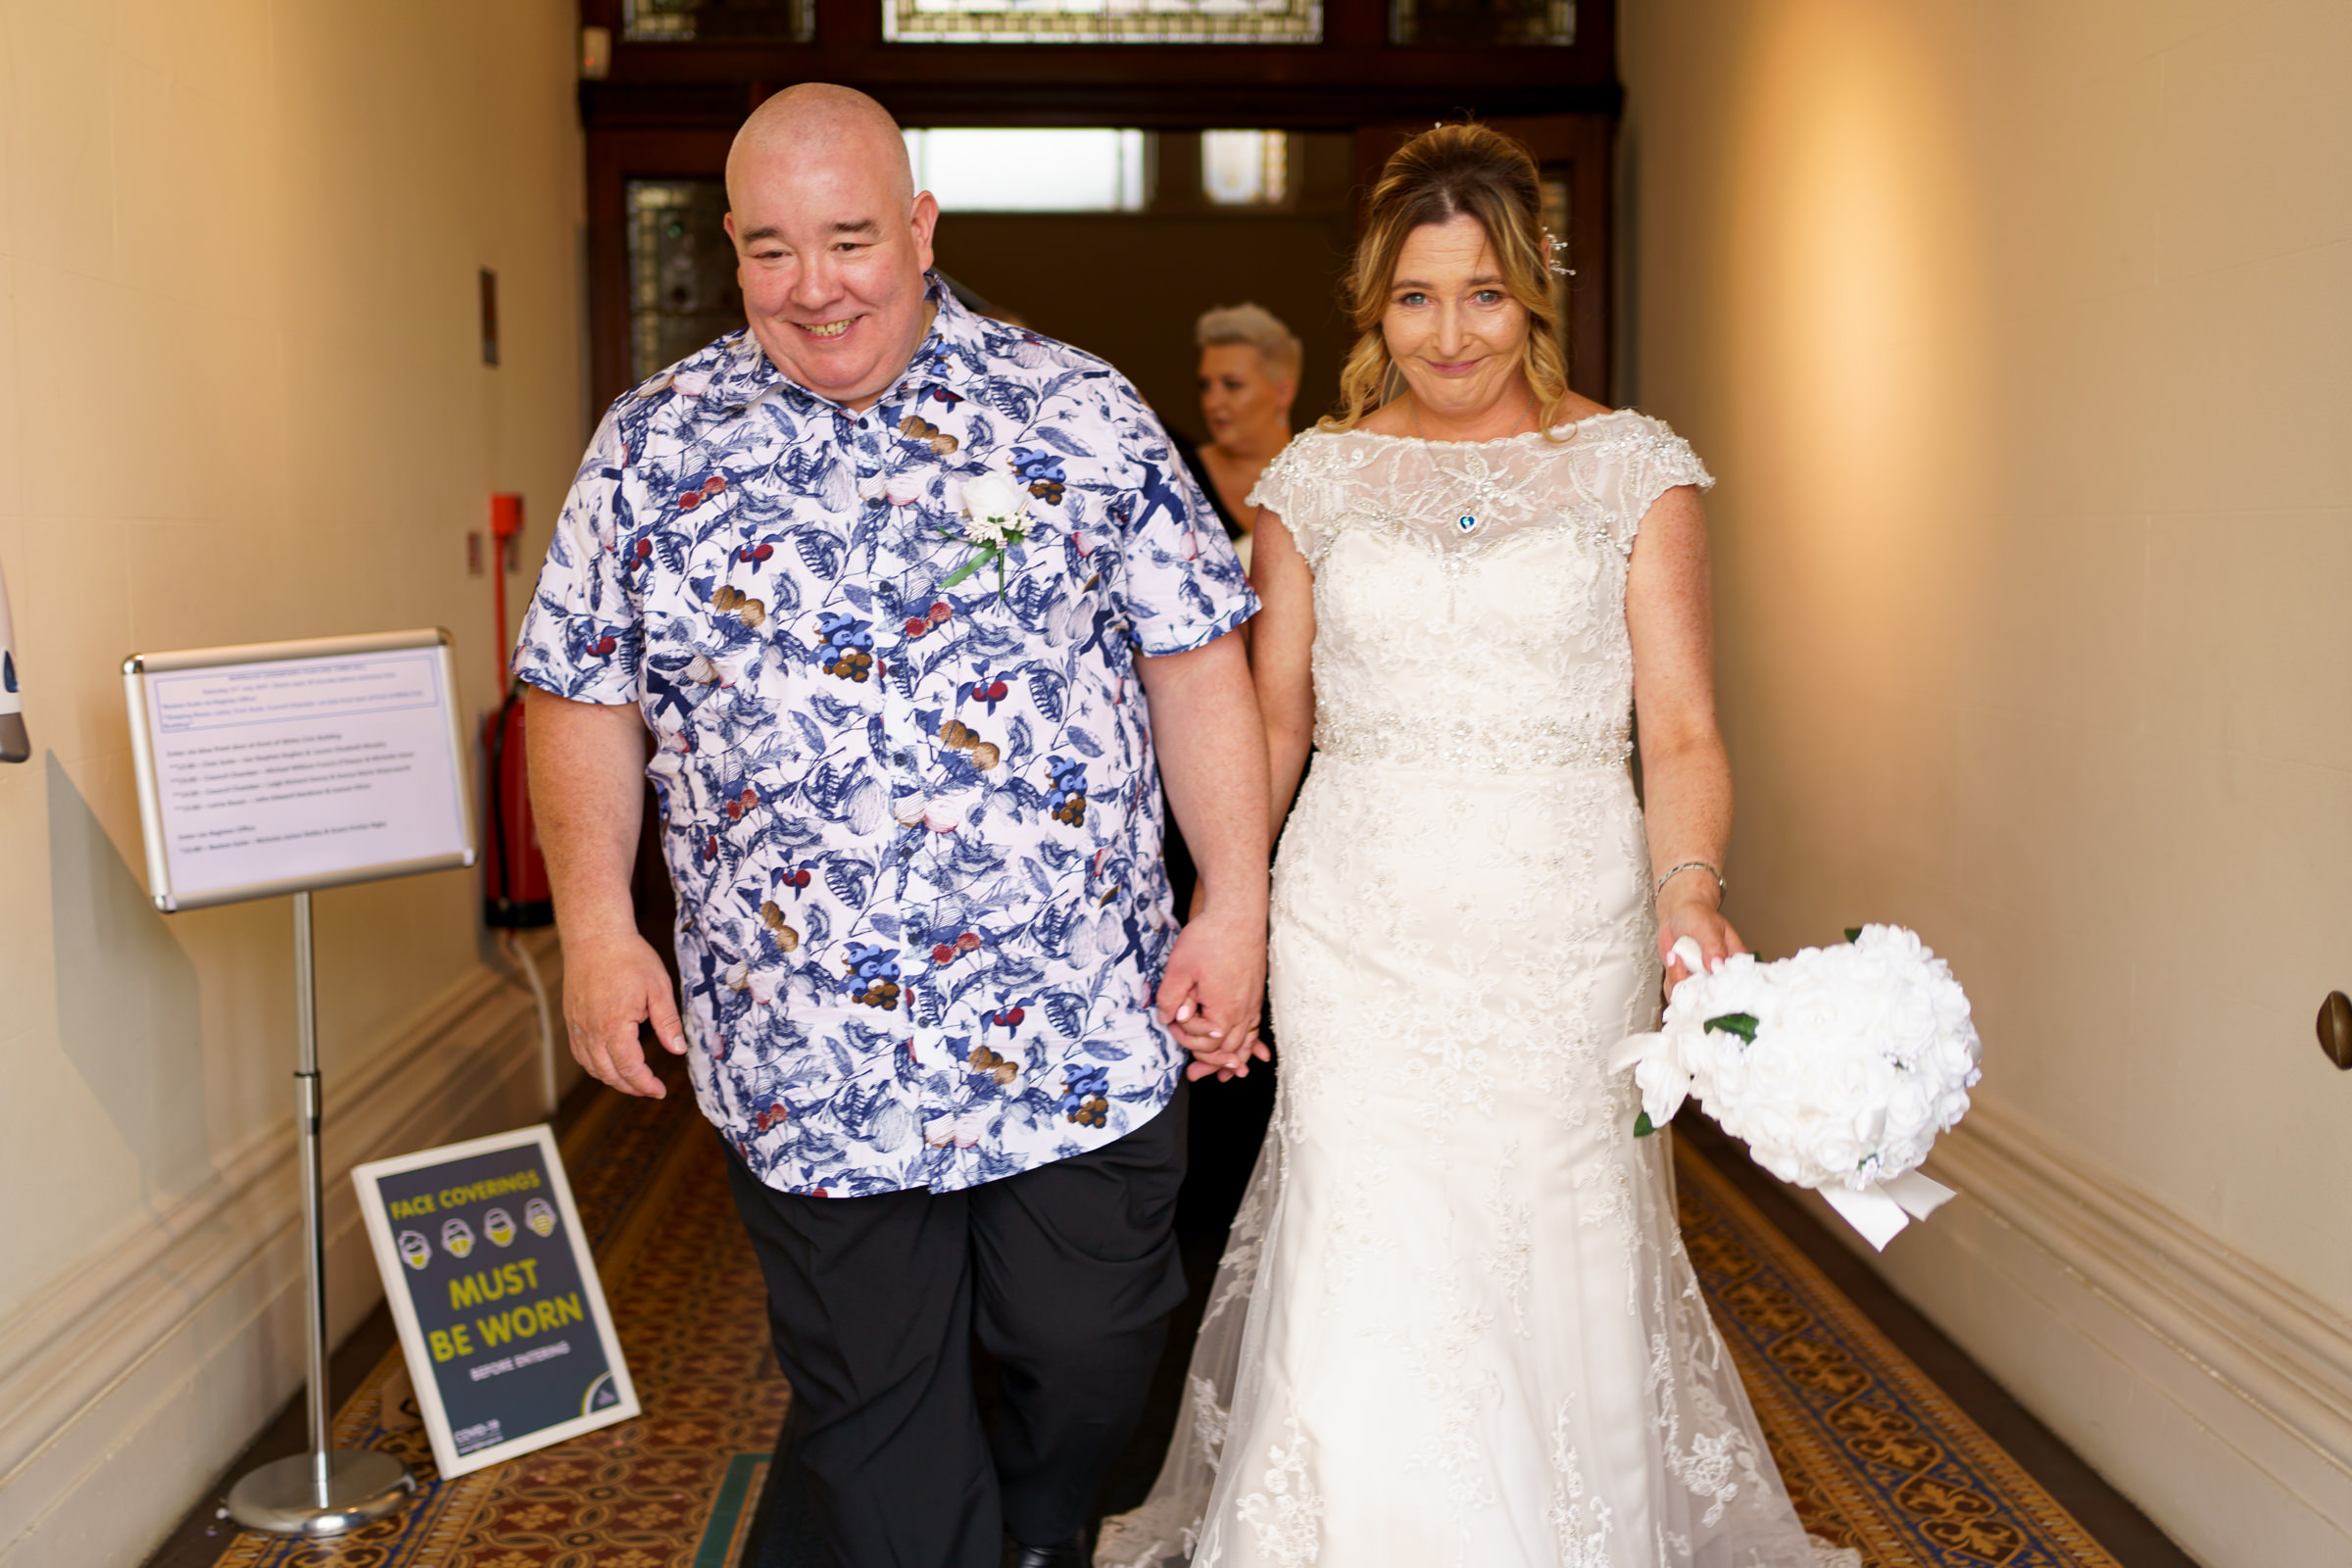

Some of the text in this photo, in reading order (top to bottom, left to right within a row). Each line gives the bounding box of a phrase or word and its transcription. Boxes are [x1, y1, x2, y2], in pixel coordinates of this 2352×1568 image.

[390, 1169, 541, 1220] FACE COVERINGS
[449, 1258, 538, 1310] MUST
[428, 1292, 584, 1362] BE WORN
[469, 1341, 570, 1381] BEFORE ENTERING
